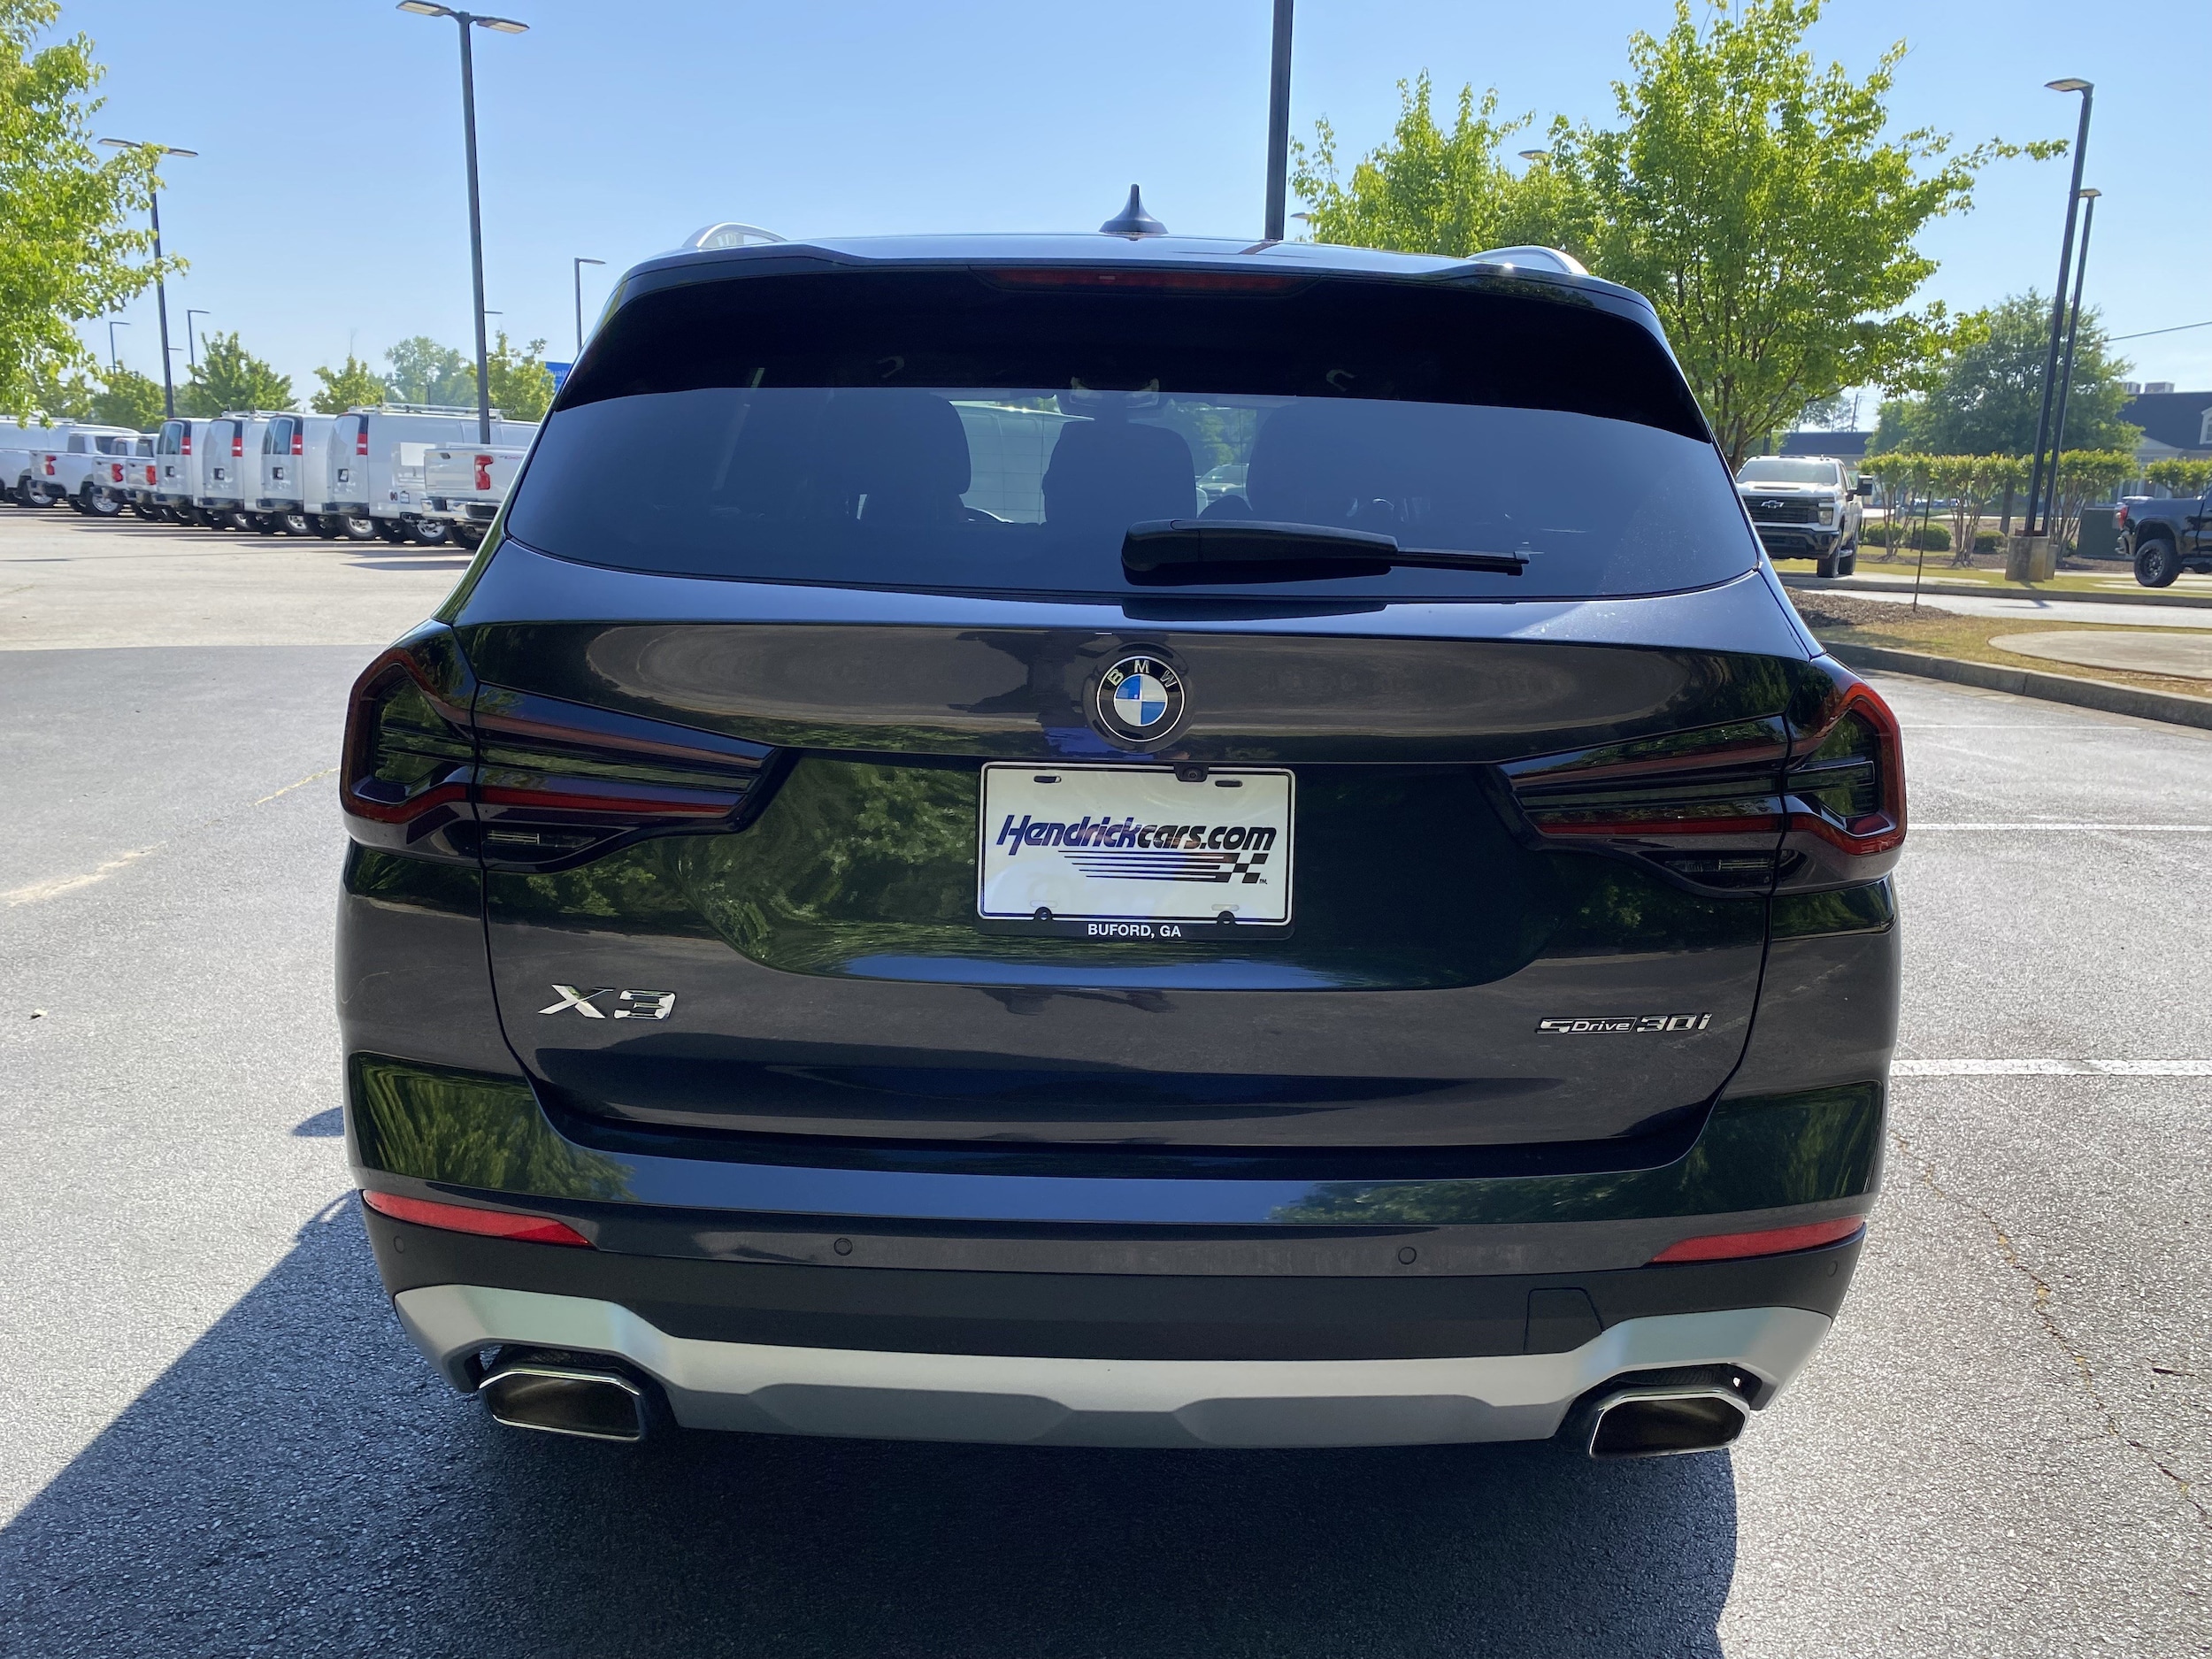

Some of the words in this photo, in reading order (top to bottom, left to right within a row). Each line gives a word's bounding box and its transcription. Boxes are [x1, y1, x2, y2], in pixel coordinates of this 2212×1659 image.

[1107, 659, 1178, 687] BMW
[995, 814, 1278, 856] Hendrickcars.com
[1087, 923, 1156, 939] BUFORD,
[1159, 925, 1182, 938] GA
[537, 983, 676, 1020] X3
